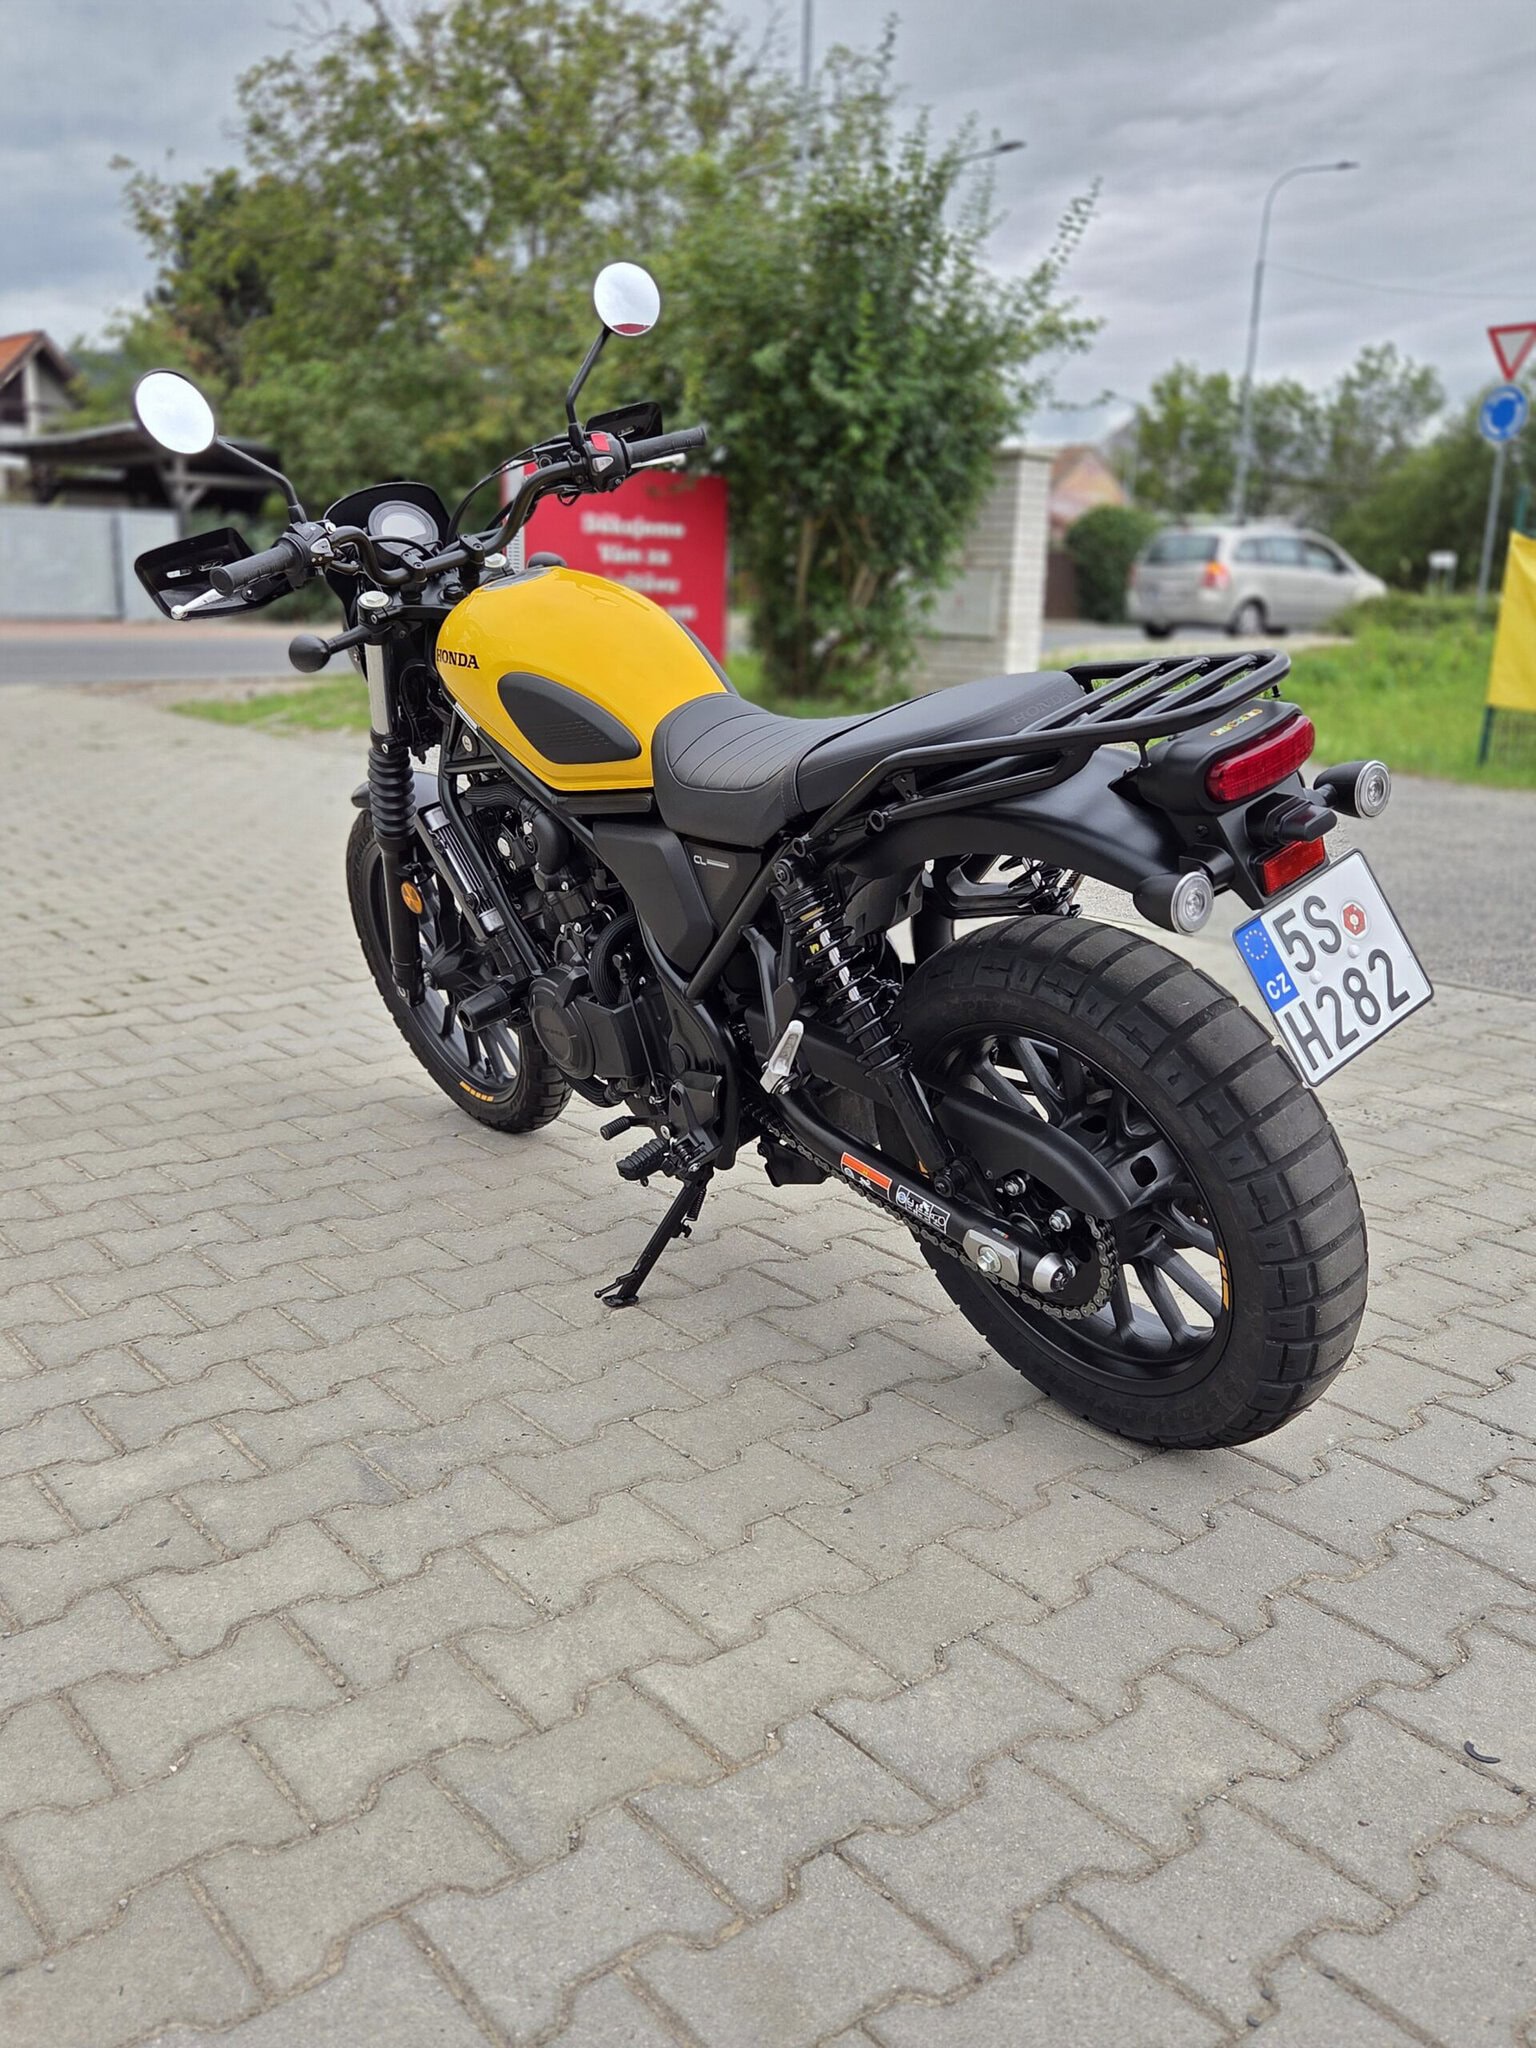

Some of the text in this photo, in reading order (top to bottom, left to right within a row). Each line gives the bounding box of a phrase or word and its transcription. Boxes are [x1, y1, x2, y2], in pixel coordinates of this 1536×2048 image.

[436, 648, 480, 670] HONDA
[1011, 692, 1071, 725] HONDA
[1272, 895, 1342, 972] 5S
[1266, 972, 1291, 1000] CZ
[1284, 948, 1411, 1071] H282
